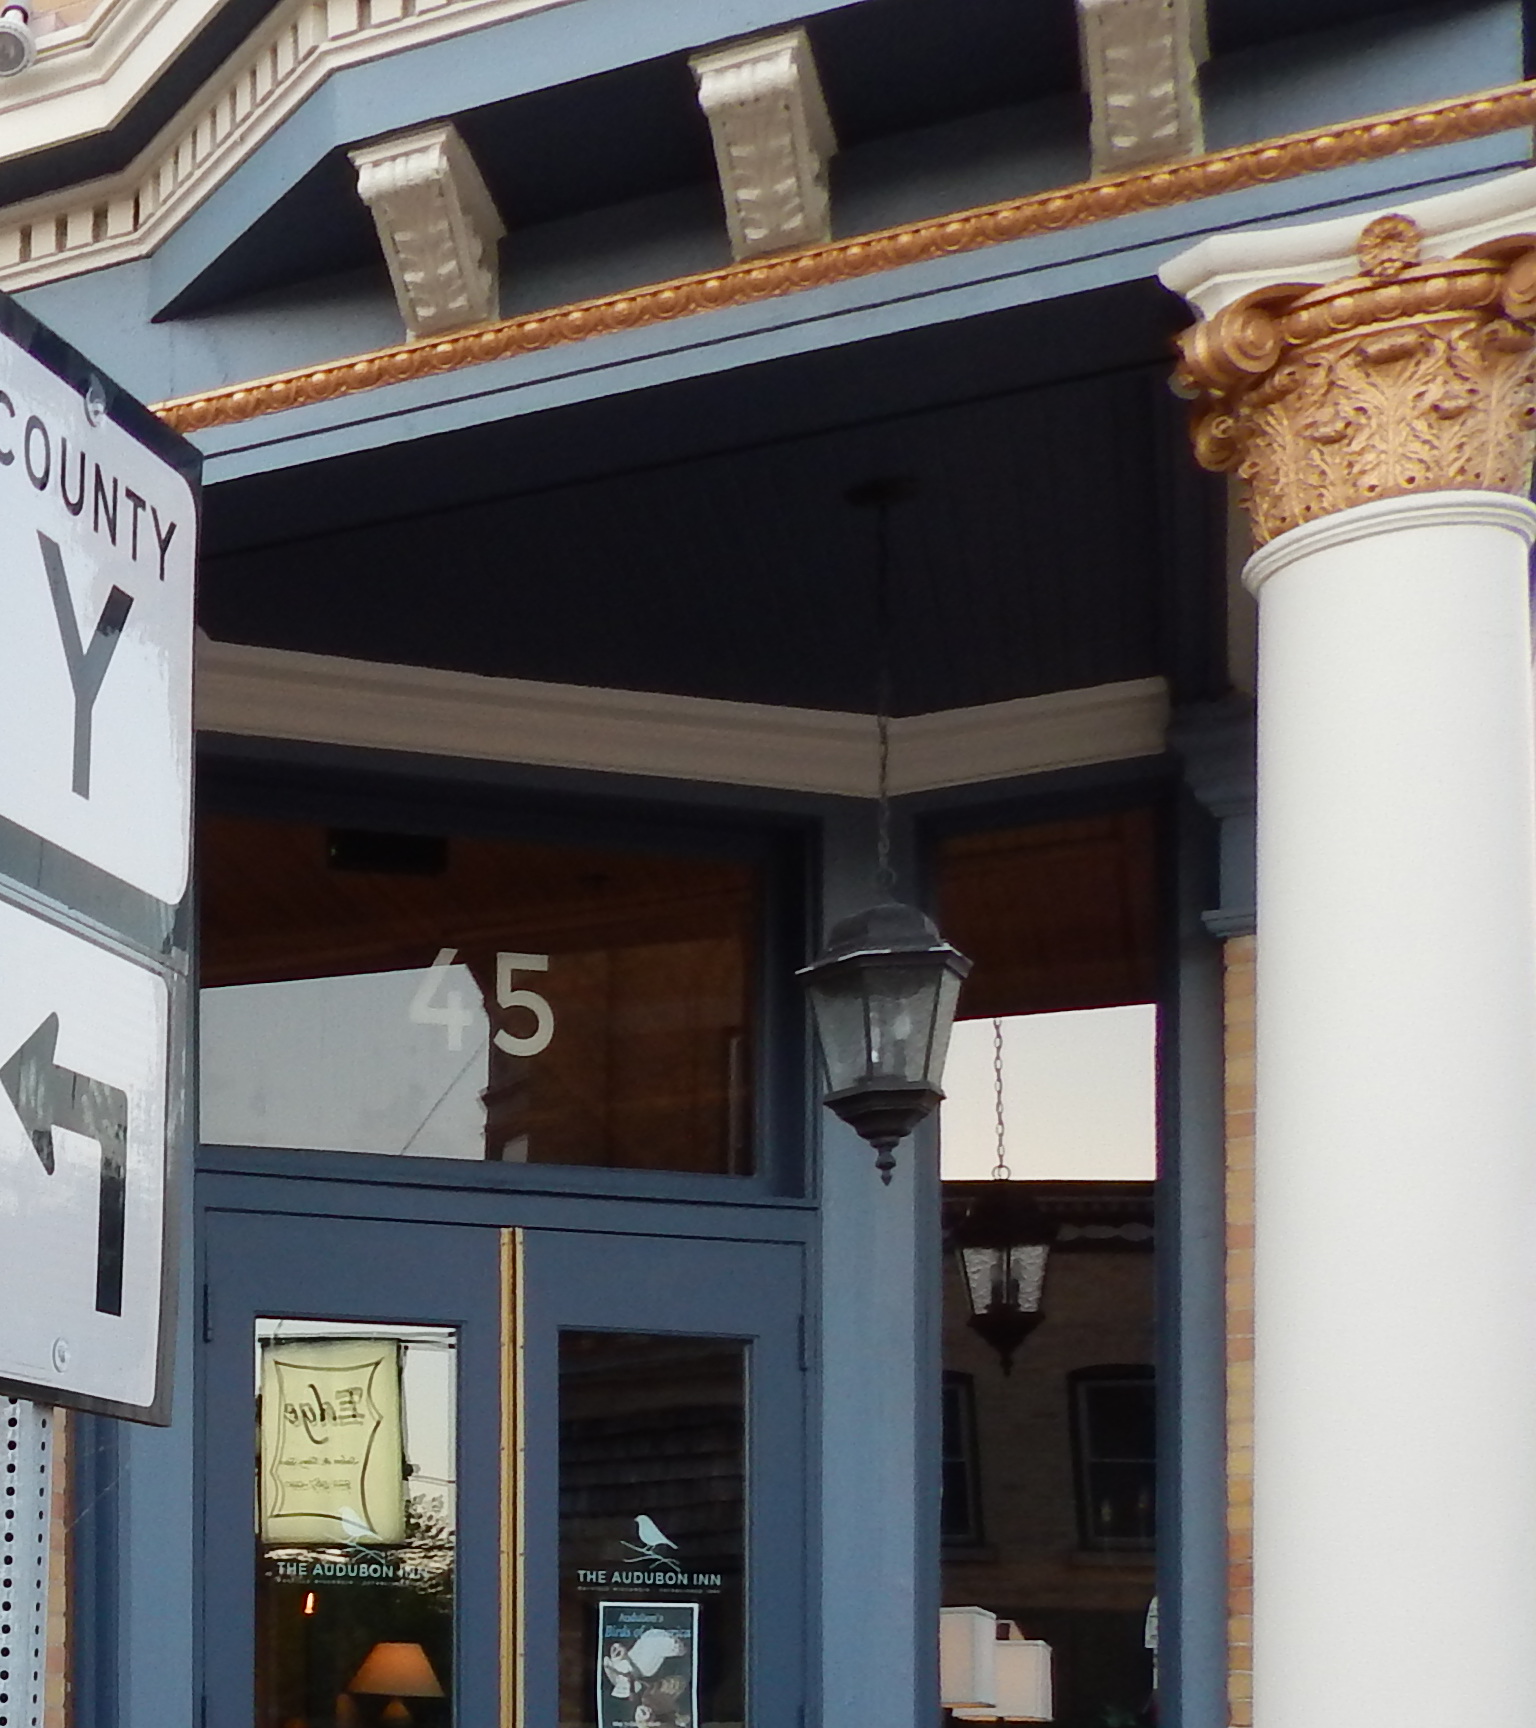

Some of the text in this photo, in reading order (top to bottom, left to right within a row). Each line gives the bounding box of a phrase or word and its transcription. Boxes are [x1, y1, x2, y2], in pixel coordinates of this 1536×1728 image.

[36, 529, 134, 801] Y
[409, 947, 555, 1057] 45
[277, 1562, 307, 1575] THE
[312, 1563, 394, 1577] AUDUBON
[577, 1570, 721, 1586] THE AUDUBON INN
